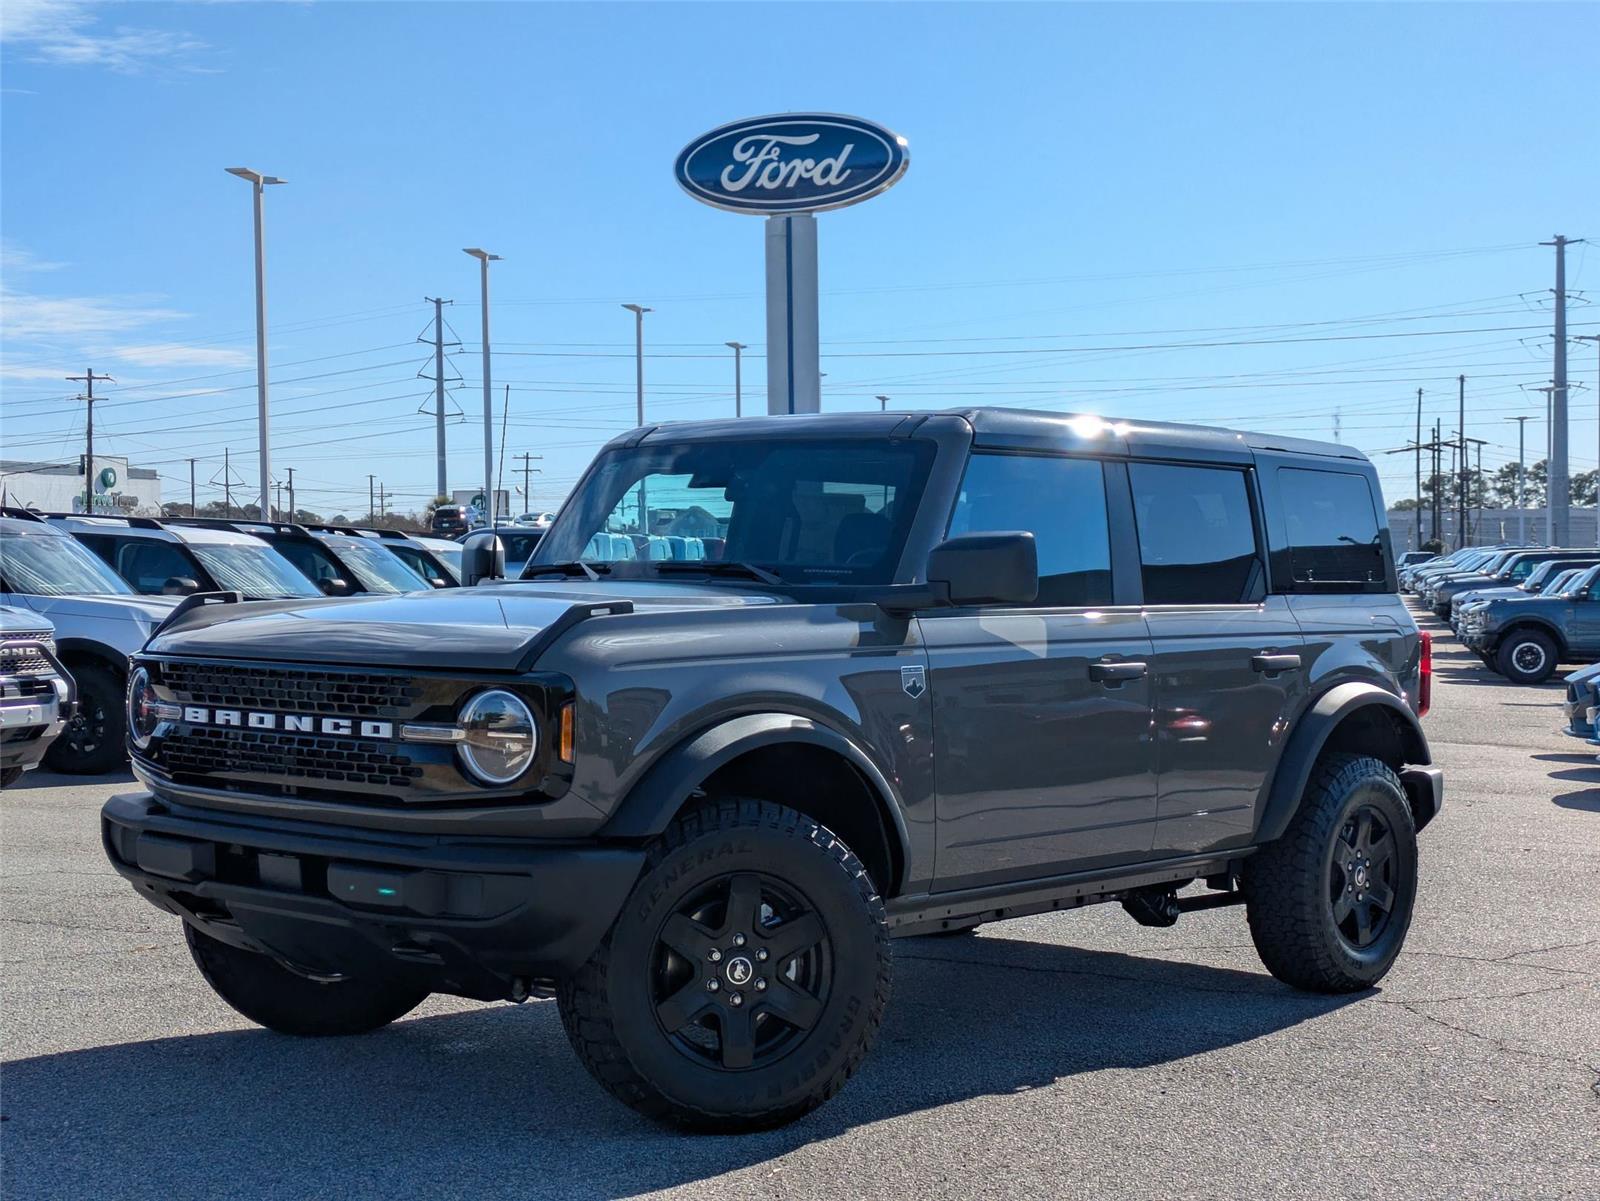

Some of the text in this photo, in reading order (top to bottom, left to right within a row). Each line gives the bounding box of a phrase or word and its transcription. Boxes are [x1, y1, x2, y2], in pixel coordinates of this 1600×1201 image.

[721, 133, 854, 191] Ford
[0, 647, 41, 656] ONC
[184, 706, 393, 738] BRONCO
[637, 839, 753, 922] GENERAL
